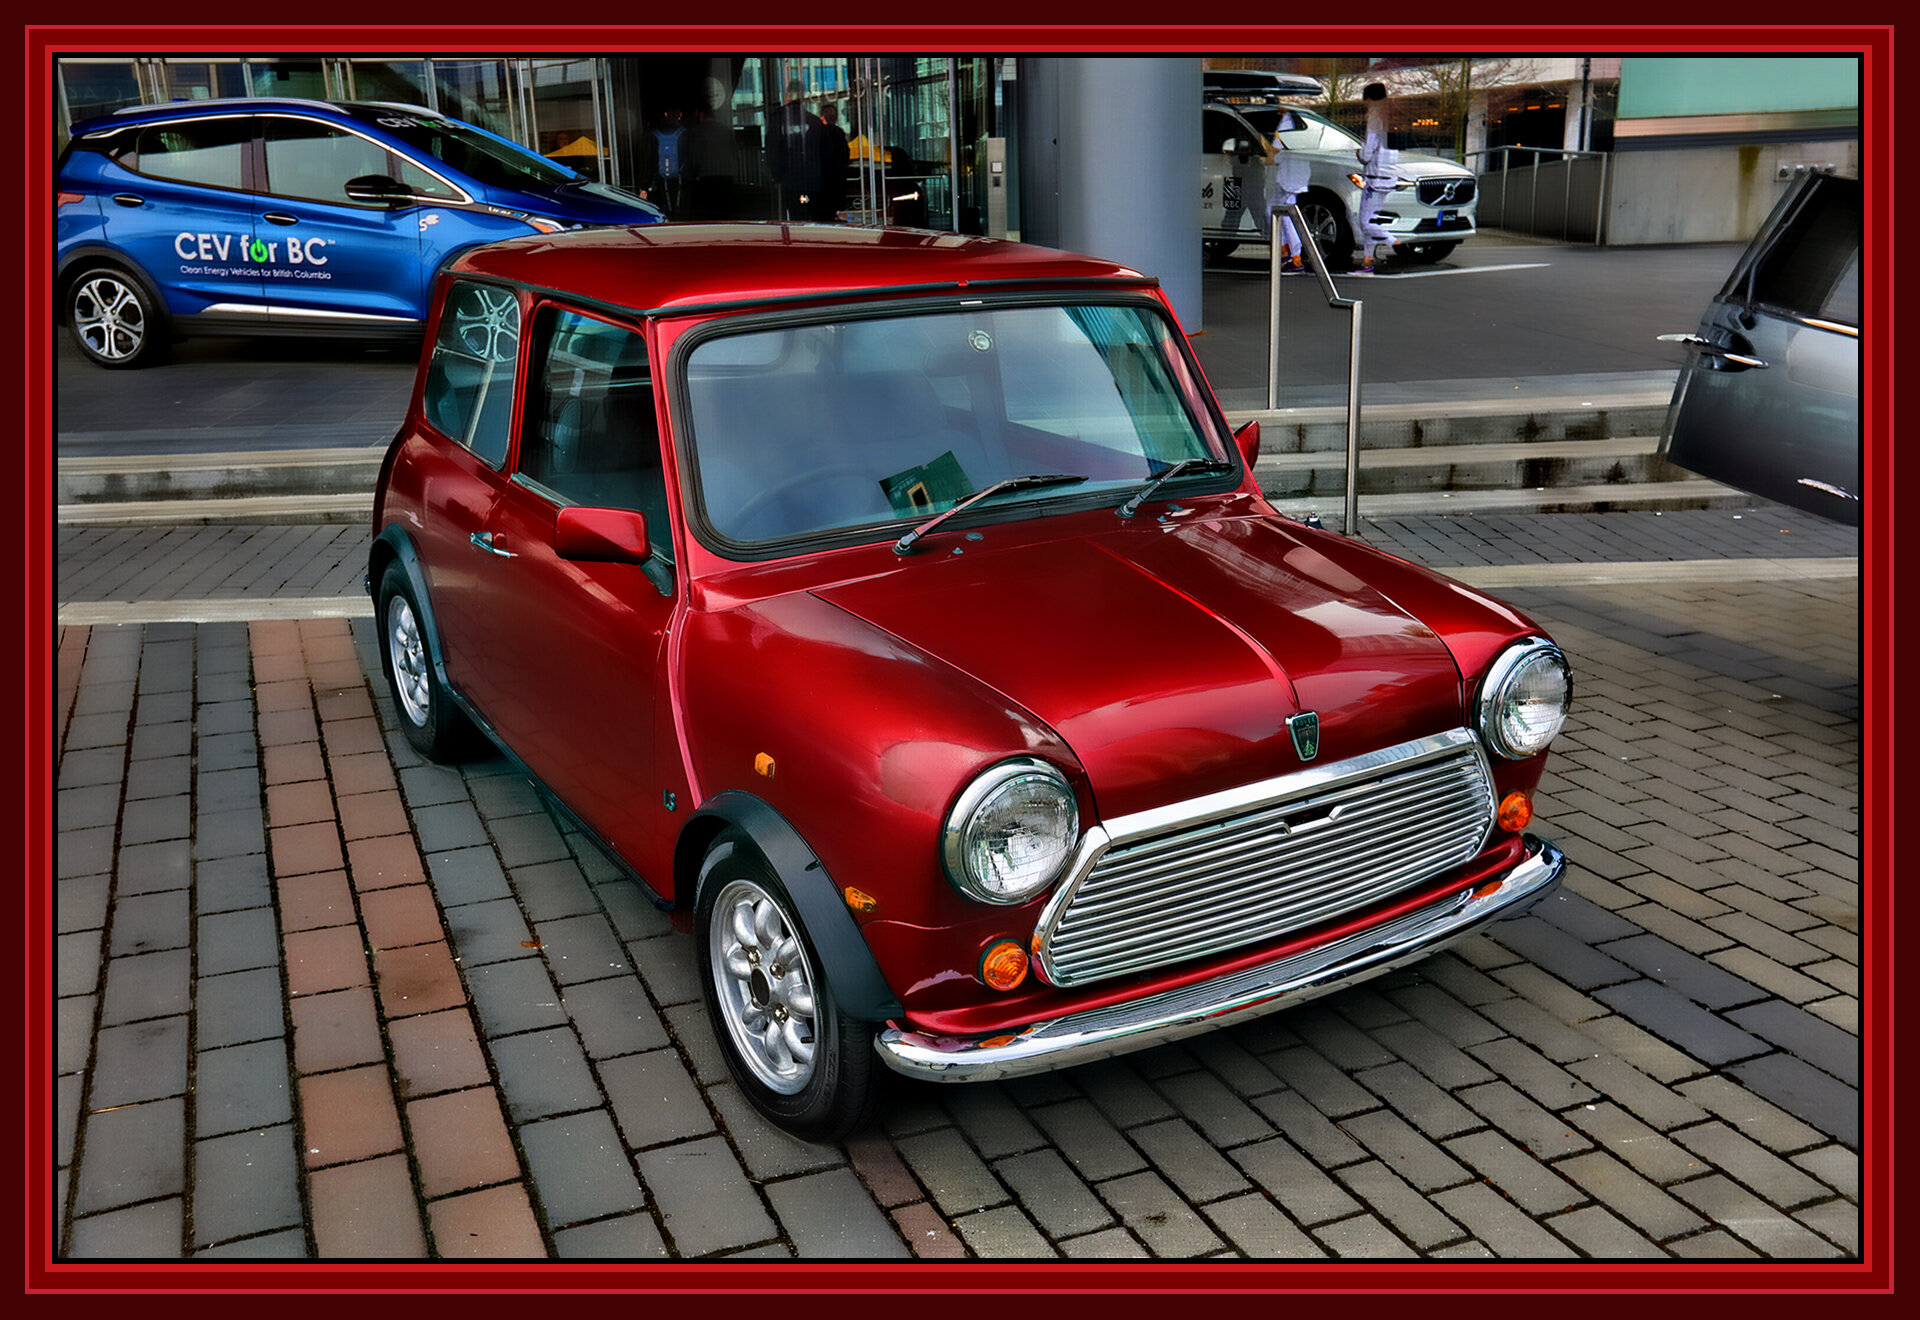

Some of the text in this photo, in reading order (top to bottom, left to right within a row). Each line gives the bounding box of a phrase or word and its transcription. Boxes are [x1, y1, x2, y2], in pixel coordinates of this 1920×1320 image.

[1224, 200, 1240, 209] RBC
[174, 232, 232, 261] CEV
[180, 264, 332, 280] Clean Energy Vehicles for British Columbia
